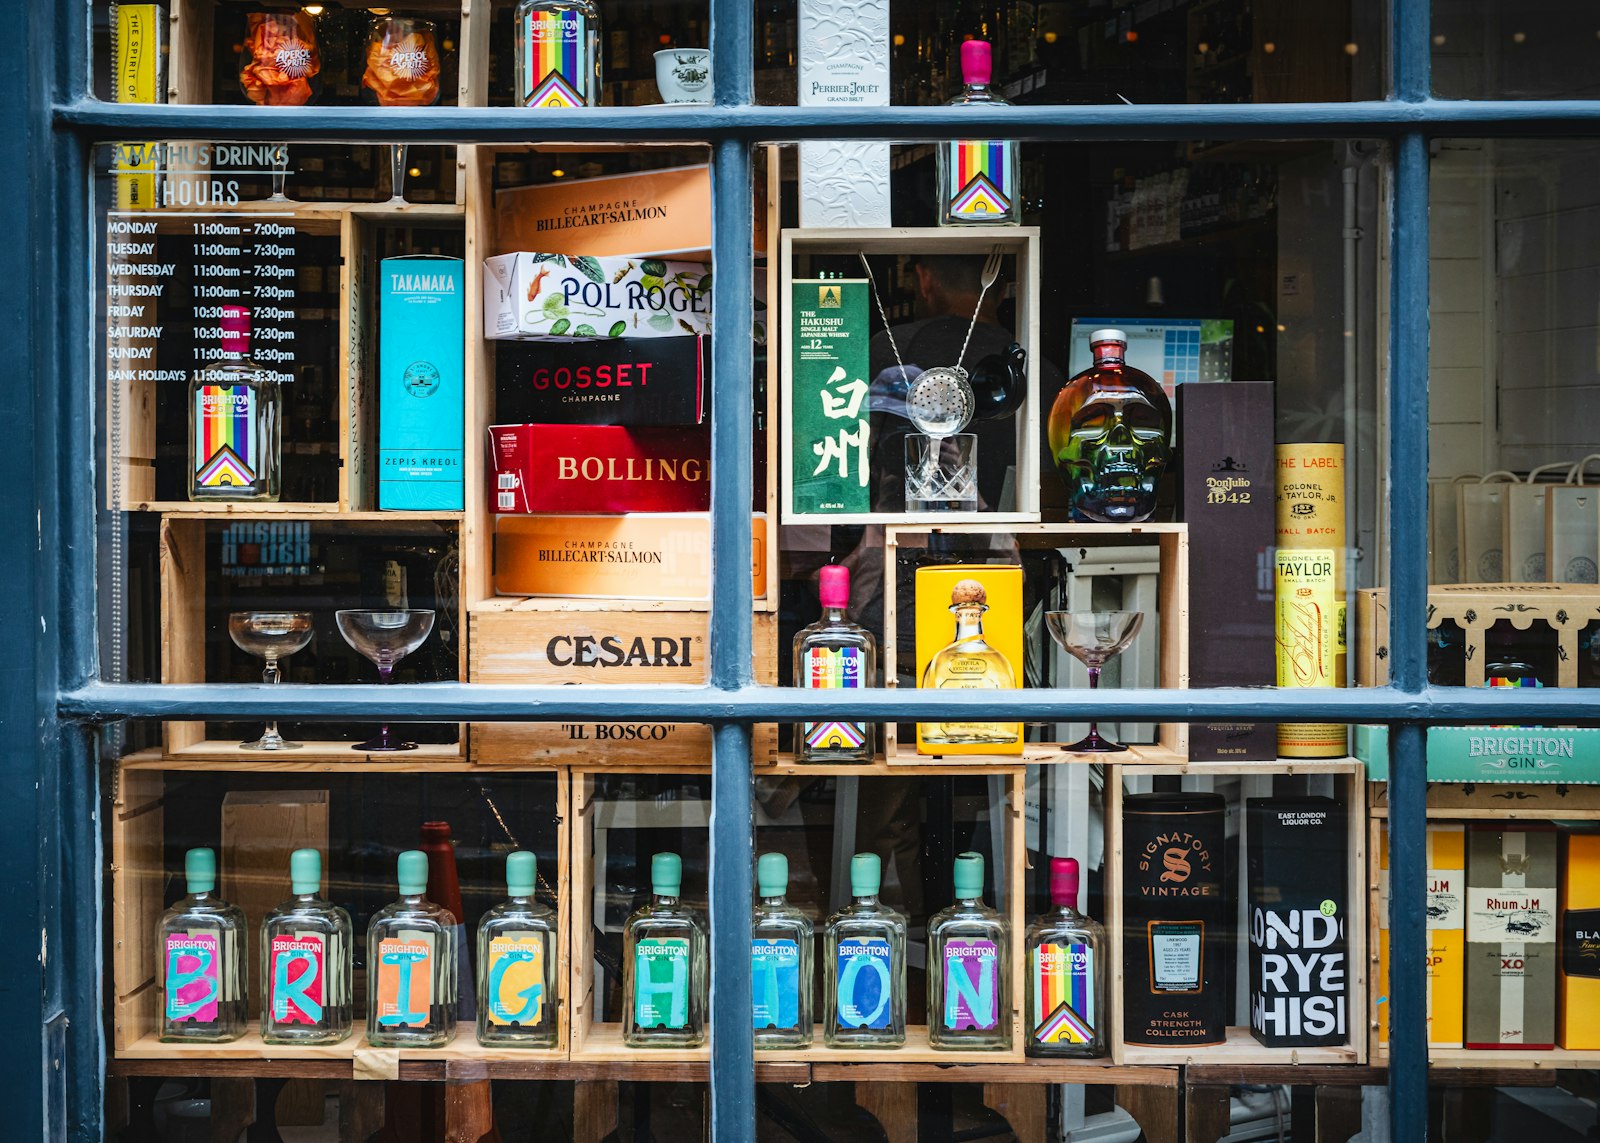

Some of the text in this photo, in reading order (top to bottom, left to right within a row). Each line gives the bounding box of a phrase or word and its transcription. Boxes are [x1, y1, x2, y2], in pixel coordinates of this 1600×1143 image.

[530, 20, 580, 31] BRIGHTON
[128, 41, 139, 79] SPIRIT
[276, 48, 311, 64] APEROL
[282, 57, 307, 68] SPRITZ
[390, 51, 428, 65] APEROL
[397, 59, 423, 70] SPRITZ
[826, 63, 864, 71] CHAMPAGNE
[128, 85, 137, 99] OF
[113, 145, 210, 166] AMATHUS
[216, 145, 289, 166] DRINKS
[163, 180, 239, 206] HOURS
[564, 199, 638, 215] CHAMPAGNE
[536, 205, 668, 232] BILLECART-SALMON
[107, 222, 295, 238] MONDAY 11:00am 7:00pm
[107, 243, 295, 258] TUESDAY 11:00am 7:30pm
[107, 264, 295, 279] WEDNESDAY 11:00am 7:30pm
[391, 274, 455, 292] TAKAMAKA
[107, 285, 295, 300] THURSDAY 11:00am 7:30pm
[560, 277, 713, 313] POL ROGE
[108, 306, 295, 321] FRIDAY 10:30am 7:30pm
[800, 318, 844, 326] HAKUSHU
[108, 327, 295, 342] SATURDAY 10:30am 7:30pm
[810, 339, 822, 350] 12
[108, 348, 295, 363] SUNDAY 11:00am 5:30pm
[108, 370, 295, 384] BANK HOLIDAYS 11:00am 5:30pm
[532, 362, 653, 390] GOSSET
[201, 394, 250, 405] BRIGHTON
[562, 394, 621, 404] CHAMPAGNE
[813, 366, 870, 487] 白州
[385, 457, 458, 466] ZEPIS KREOL
[1276, 458, 1338, 469] THE LABEL
[557, 456, 711, 482] BOLLING
[1207, 492, 1251, 504] 1942
[1287, 492, 1337, 503] TAYLOR, JR.
[564, 541, 635, 550] CHAMPAGNE
[538, 550, 663, 564] BILLECART-SALMON
[1278, 563, 1332, 576] TAYLOR
[545, 635, 692, 668] CESARI
[810, 656, 860, 668] BRIGHTON
[561, 724, 676, 740] "IL BOSCO"
[1469, 737, 1574, 758] BRIGHTON
[1508, 758, 1535, 768] GIN
[1278, 812, 1296, 820] EAST
[1140, 832, 1212, 872] SIGNATORY
[1142, 886, 1210, 896] VINTAGE
[1487, 899, 1540, 910] Rhum J.M
[1250, 904, 1344, 950] LOND
[168, 940, 216, 950] BRIGHTON
[273, 940, 322, 953] BRIGHTON
[381, 944, 429, 956] BRIGHTON
[491, 943, 541, 954] BRIGHTON
[638, 945, 687, 957] BRIGHTON
[839, 946, 889, 956] BRIGHTON
[946, 947, 995, 958] BRIGHTON
[1039, 952, 1088, 963] BRIGHTON
[1501, 960, 1524, 969] X.O
[1262, 953, 1344, 993] RYE
[166, 950, 218, 1020] B
[273, 950, 322, 1024] R
[378, 953, 428, 1024] I
[489, 951, 542, 1022] G
[638, 955, 686, 1027] H
[752, 956, 798, 1028] T
[945, 956, 996, 1028] N
[838, 958, 890, 1028] O
[1150, 1020, 1202, 1028] STRENGTH
[1146, 1028, 1206, 1037] COLLECTION
